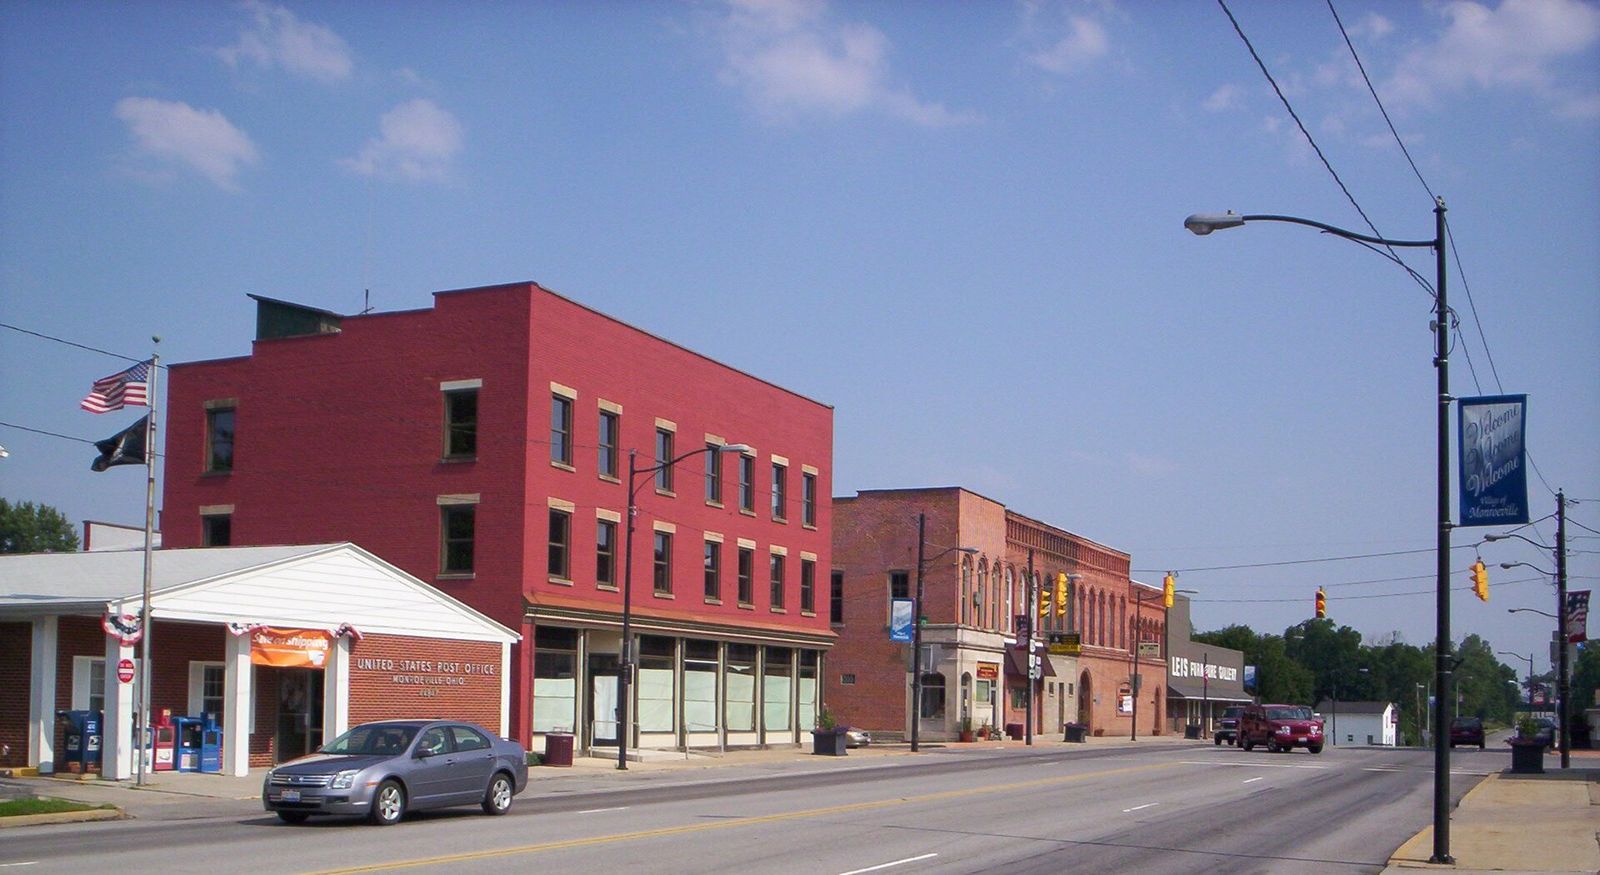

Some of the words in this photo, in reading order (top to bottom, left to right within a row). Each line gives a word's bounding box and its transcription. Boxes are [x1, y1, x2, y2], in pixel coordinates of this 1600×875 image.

[1466, 405, 1519, 443] Welcome
[1466, 431, 1519, 470] Welcome
[1466, 456, 1519, 496] Welcome
[1469, 504, 1518, 518] Monroeville
[287, 636, 329, 650] shipping
[357, 658, 394, 670] UNITED
[399, 660, 432, 672] STATES
[437, 662, 460, 673] POST
[464, 663, 495, 674] OFFICE
[1171, 656, 1189, 677] LEIS
[1190, 661, 1217, 679] FURNURE
[446, 677, 464, 685] OHIO
